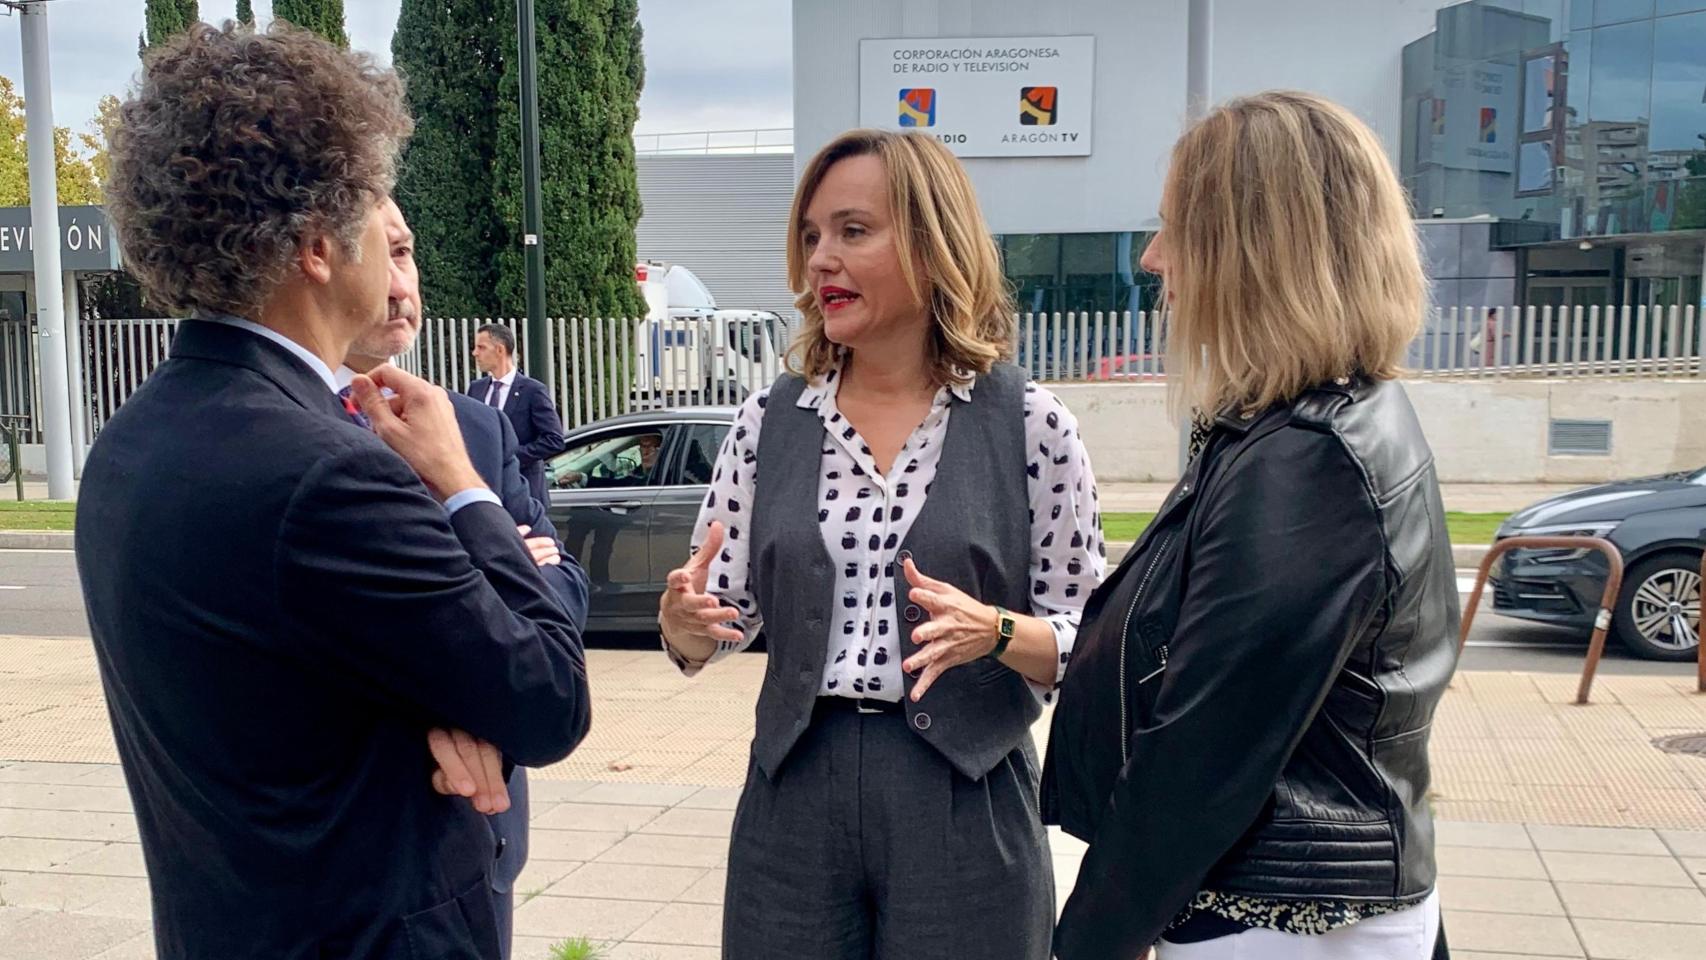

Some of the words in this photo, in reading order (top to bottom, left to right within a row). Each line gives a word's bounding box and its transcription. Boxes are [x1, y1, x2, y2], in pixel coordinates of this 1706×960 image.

[893, 46, 982, 60] CORPORACIÓN
[985, 48, 1060, 59] ARAGONESA
[893, 63, 909, 73] DE
[912, 63, 949, 73] RADIO
[954, 63, 961, 73] Y
[964, 61, 1030, 73] TELEVISIÓN
[936, 134, 967, 144] DIO
[1001, 131, 1058, 144] ARAGÓN
[1062, 133, 1079, 143] TV
[0, 217, 103, 251] EVIÓN
